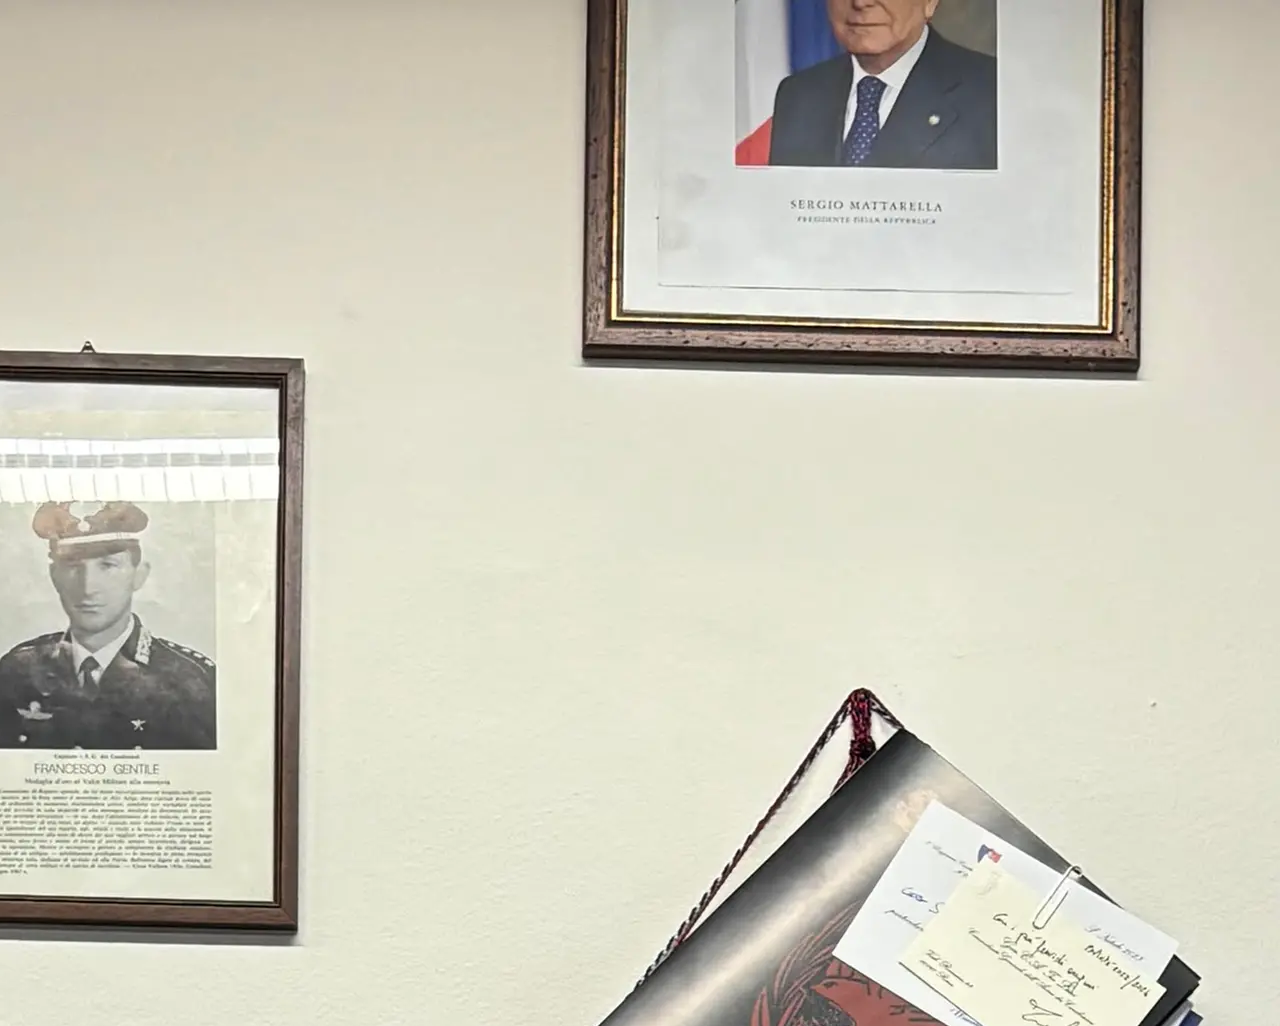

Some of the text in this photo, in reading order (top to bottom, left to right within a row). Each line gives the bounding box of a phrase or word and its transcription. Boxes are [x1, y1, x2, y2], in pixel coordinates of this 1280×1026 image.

[789, 199, 943, 213] SERGIO MATTARELLA
[33, 762, 160, 776] FRANCESCO GENTILE
